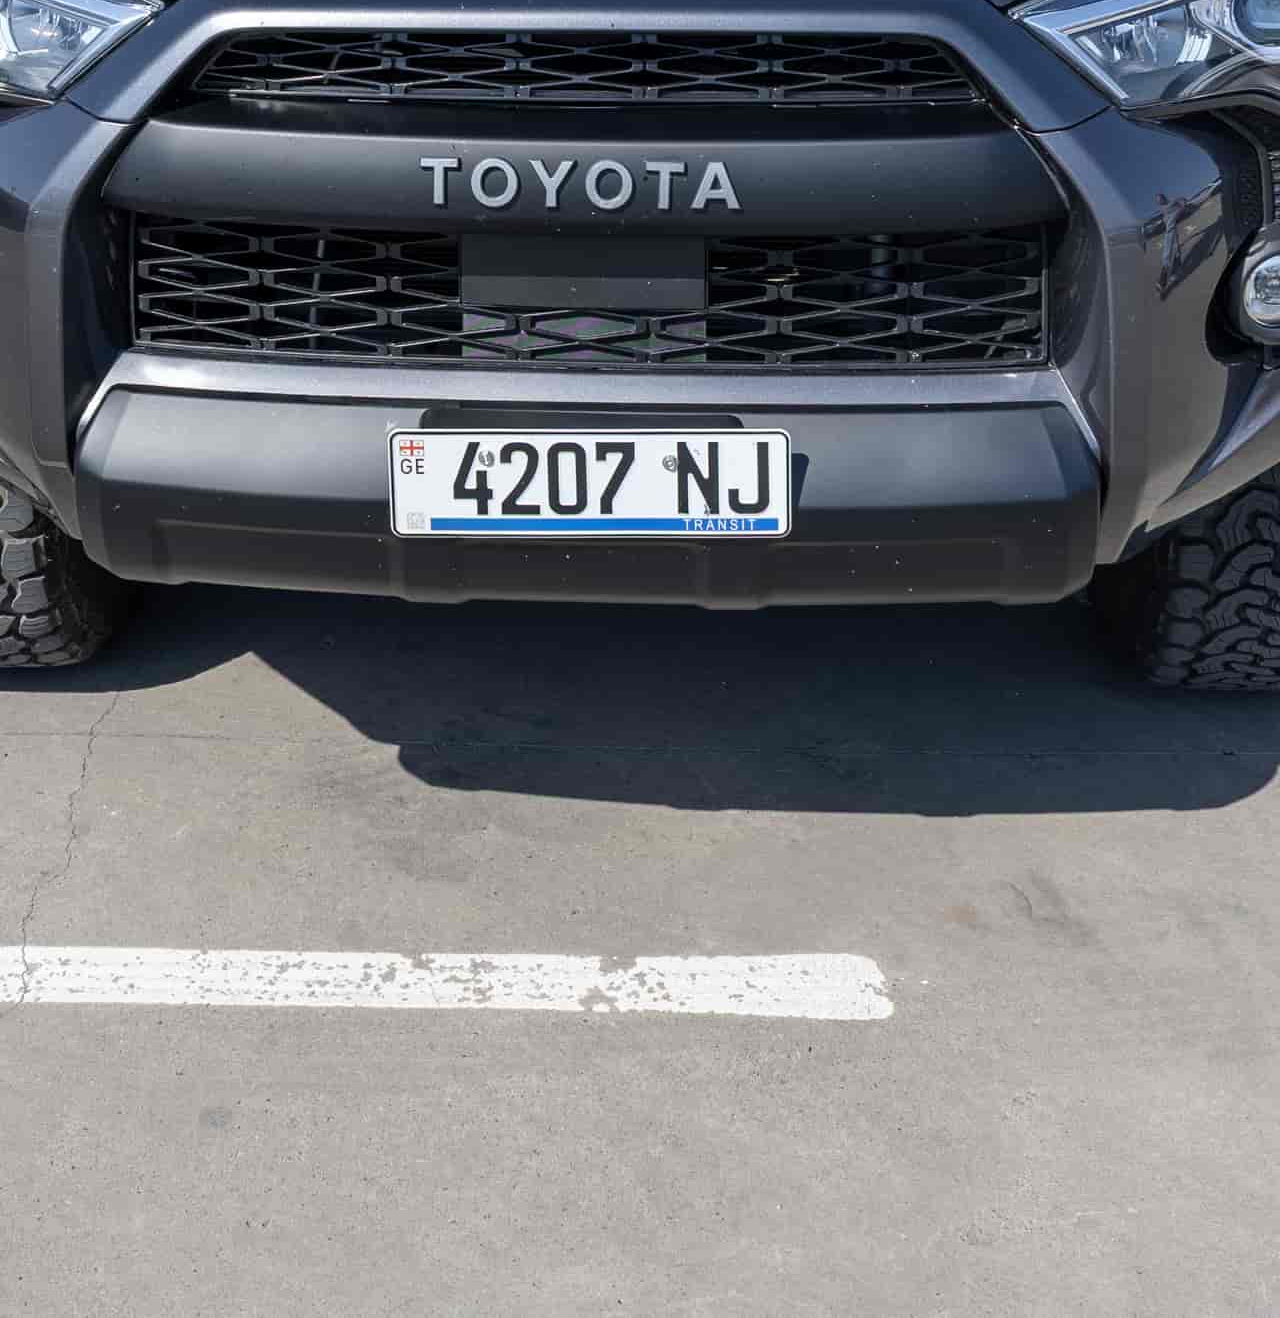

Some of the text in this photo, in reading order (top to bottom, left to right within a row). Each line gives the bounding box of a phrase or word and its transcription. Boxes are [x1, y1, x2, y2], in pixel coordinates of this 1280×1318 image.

[419, 157, 742, 210] TOYOTA
[400, 458, 424, 475] GE
[452, 441, 770, 516] 4207 NJ
[683, 518, 757, 531] TRANSIT
